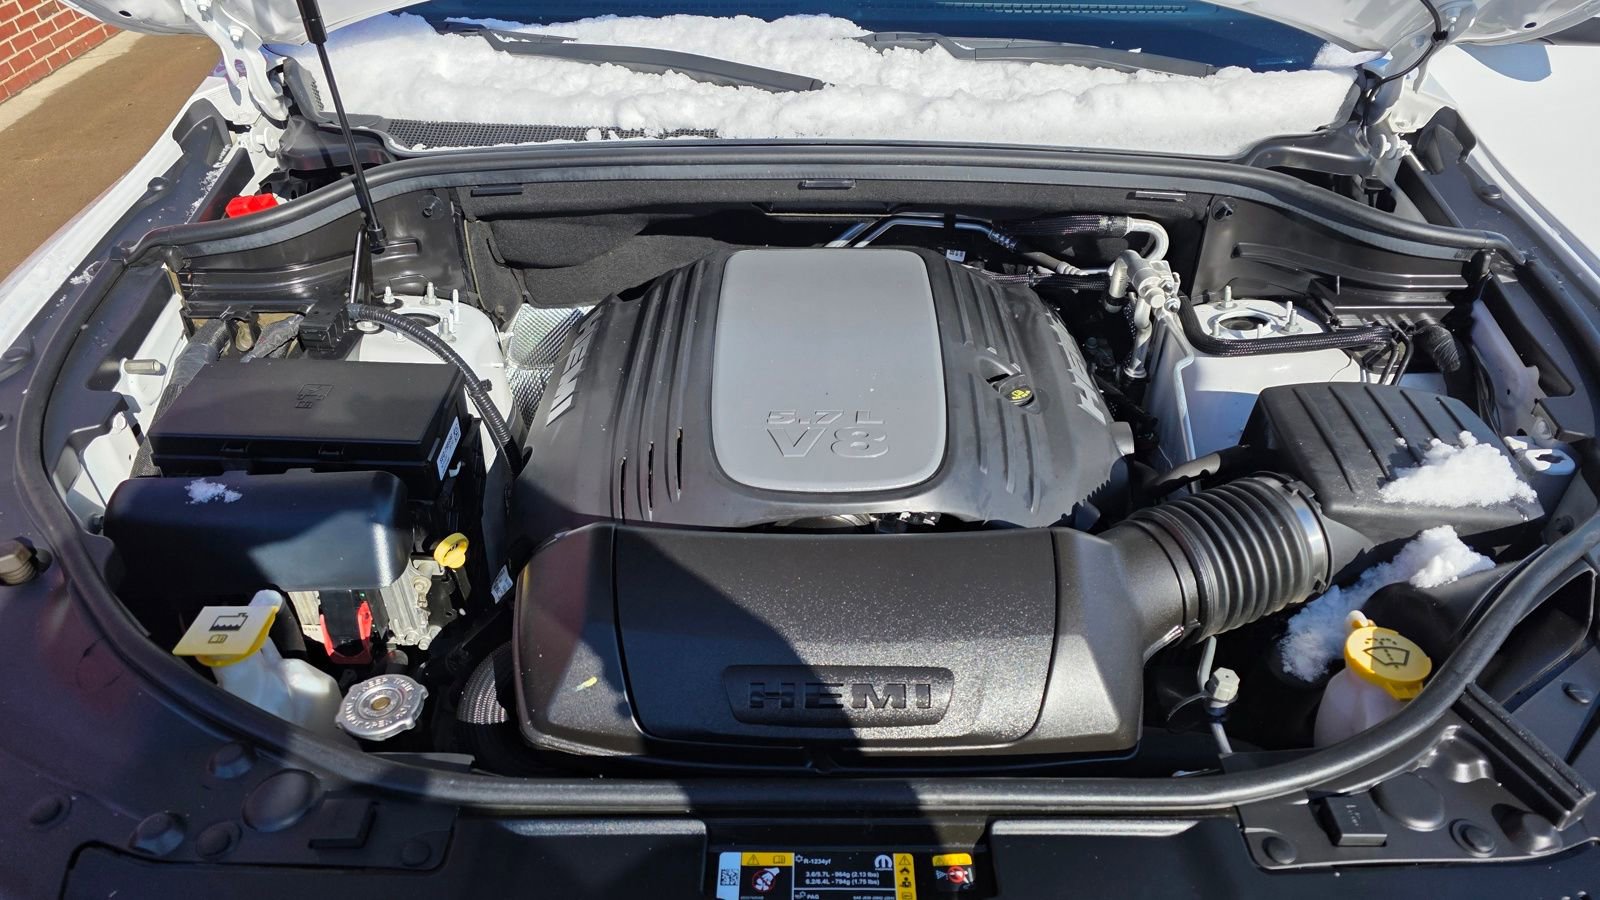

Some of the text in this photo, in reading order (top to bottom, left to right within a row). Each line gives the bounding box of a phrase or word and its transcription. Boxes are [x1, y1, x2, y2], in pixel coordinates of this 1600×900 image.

[546, 306, 602, 426] HEMI
[766, 426, 889, 459] V8
[749, 682, 931, 709] HEMI
[364, 719, 393, 729] OPEN
[803, 858, 831, 867] R-1234yf
